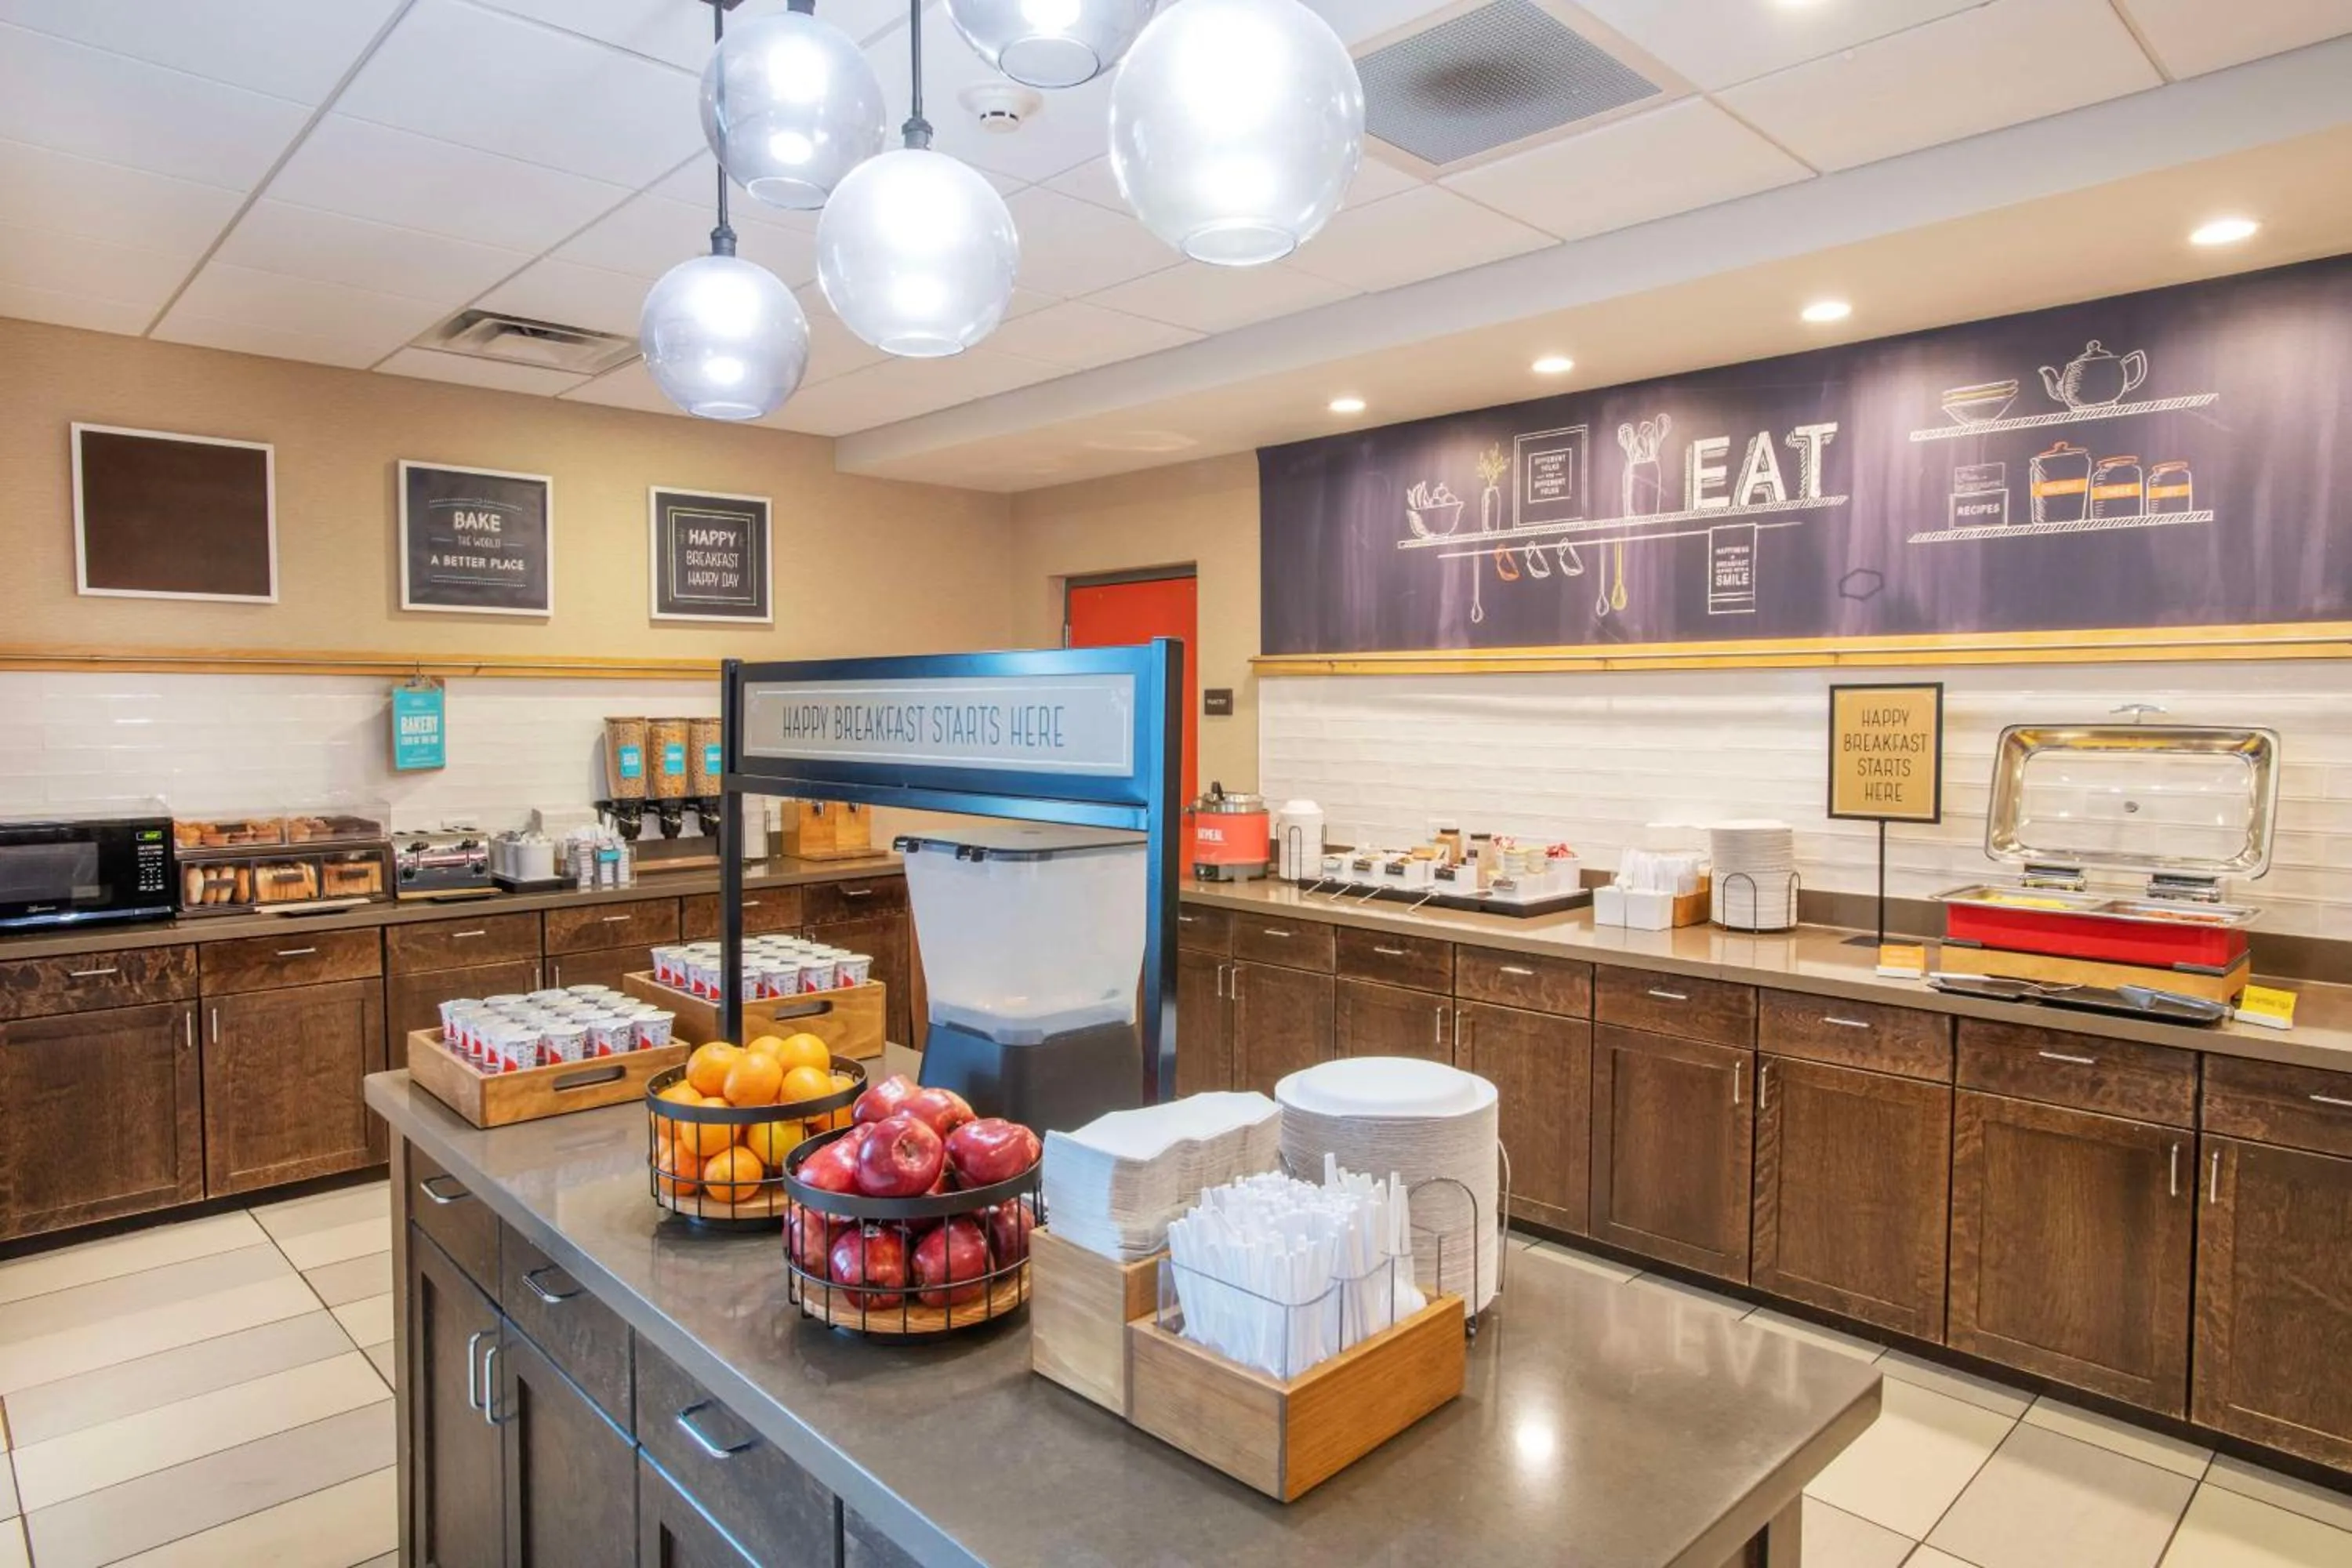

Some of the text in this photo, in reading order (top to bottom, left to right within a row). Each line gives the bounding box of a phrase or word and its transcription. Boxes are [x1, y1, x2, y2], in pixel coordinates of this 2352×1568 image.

[1685, 421, 1838, 511] EAT
[1957, 502, 2000, 517] RECIPES
[453, 511, 502, 533] BAKE
[458, 535, 501, 548] THE WORLD
[688, 528, 737, 547] HAPPY
[430, 554, 524, 571] A BETTER PLACE
[686, 550, 739, 568] BREAKFAST
[688, 571, 739, 588] HAPPY DAY
[1715, 572, 1749, 586] SMILE
[401, 715, 438, 735] BAKERY
[783, 705, 1065, 749] HAPPY BREAKFAST STARTS HERE
[1861, 708, 1909, 728] HAPPY
[1843, 733, 1929, 753] BREAKFAST
[1857, 757, 1911, 777] STARTS
[1864, 782, 1904, 802] HERE
